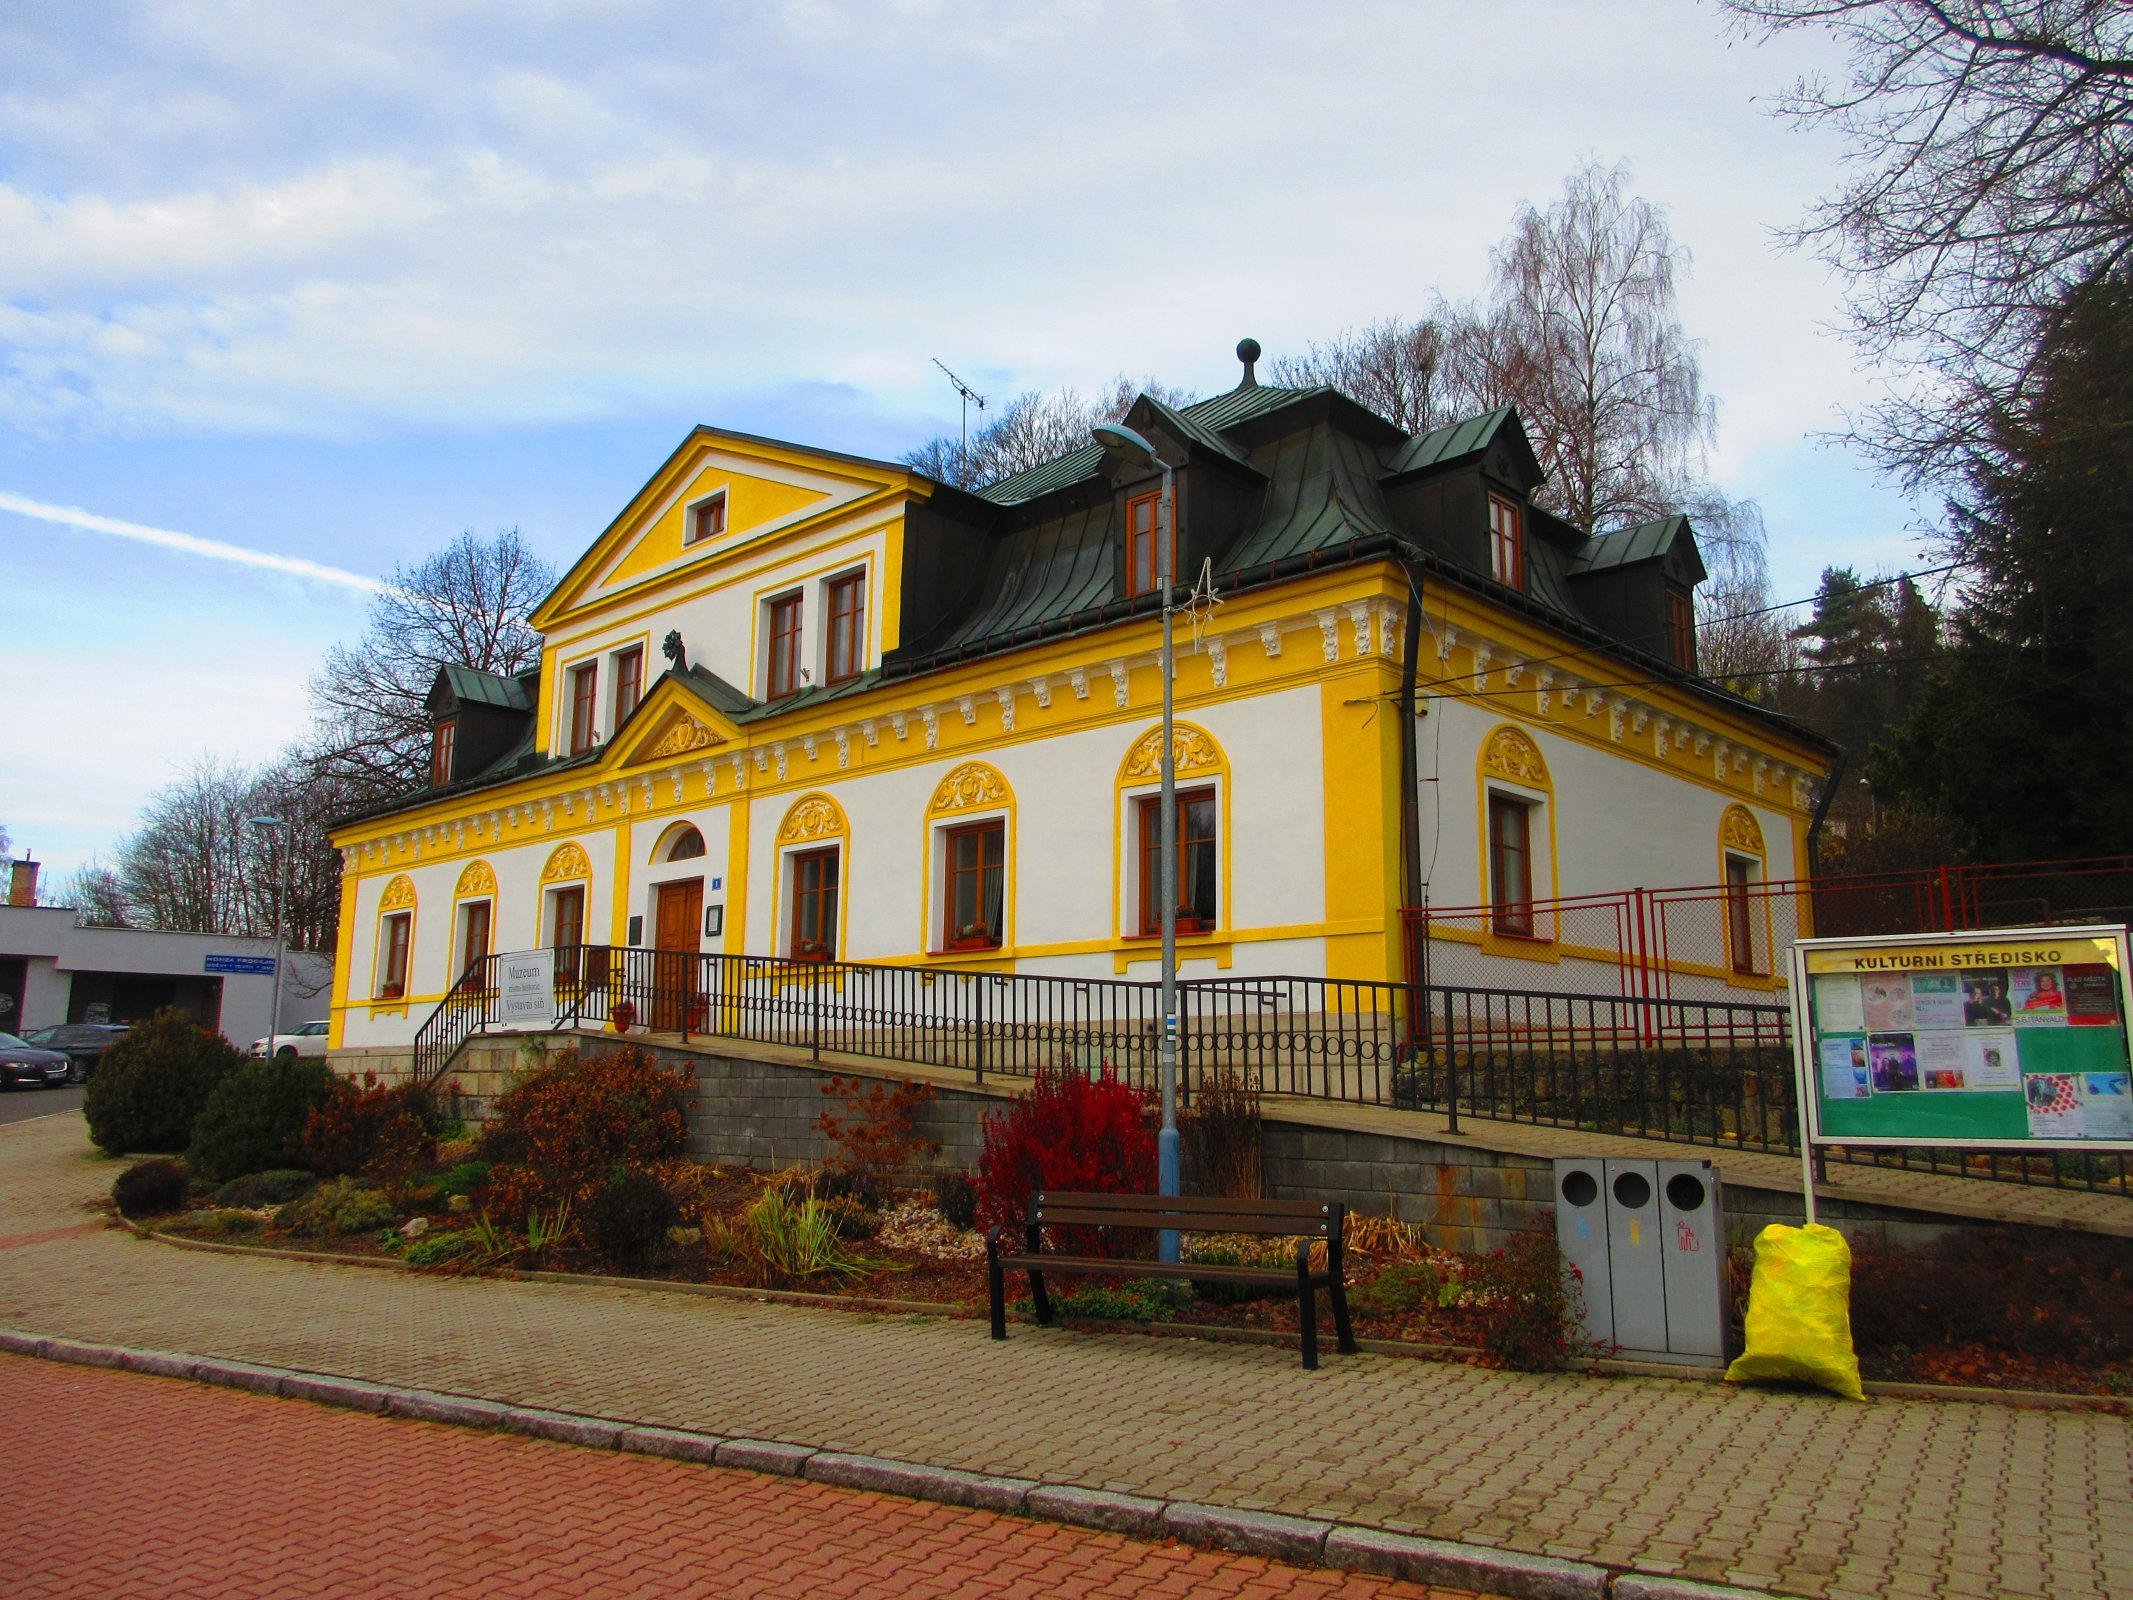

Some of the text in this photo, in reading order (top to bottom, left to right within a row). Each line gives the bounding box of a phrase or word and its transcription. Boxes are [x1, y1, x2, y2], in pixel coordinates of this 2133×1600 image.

[1854, 950, 2062, 969] KULTURNÍ STŘEDISKO
[508, 967, 540, 979] Muzeum
